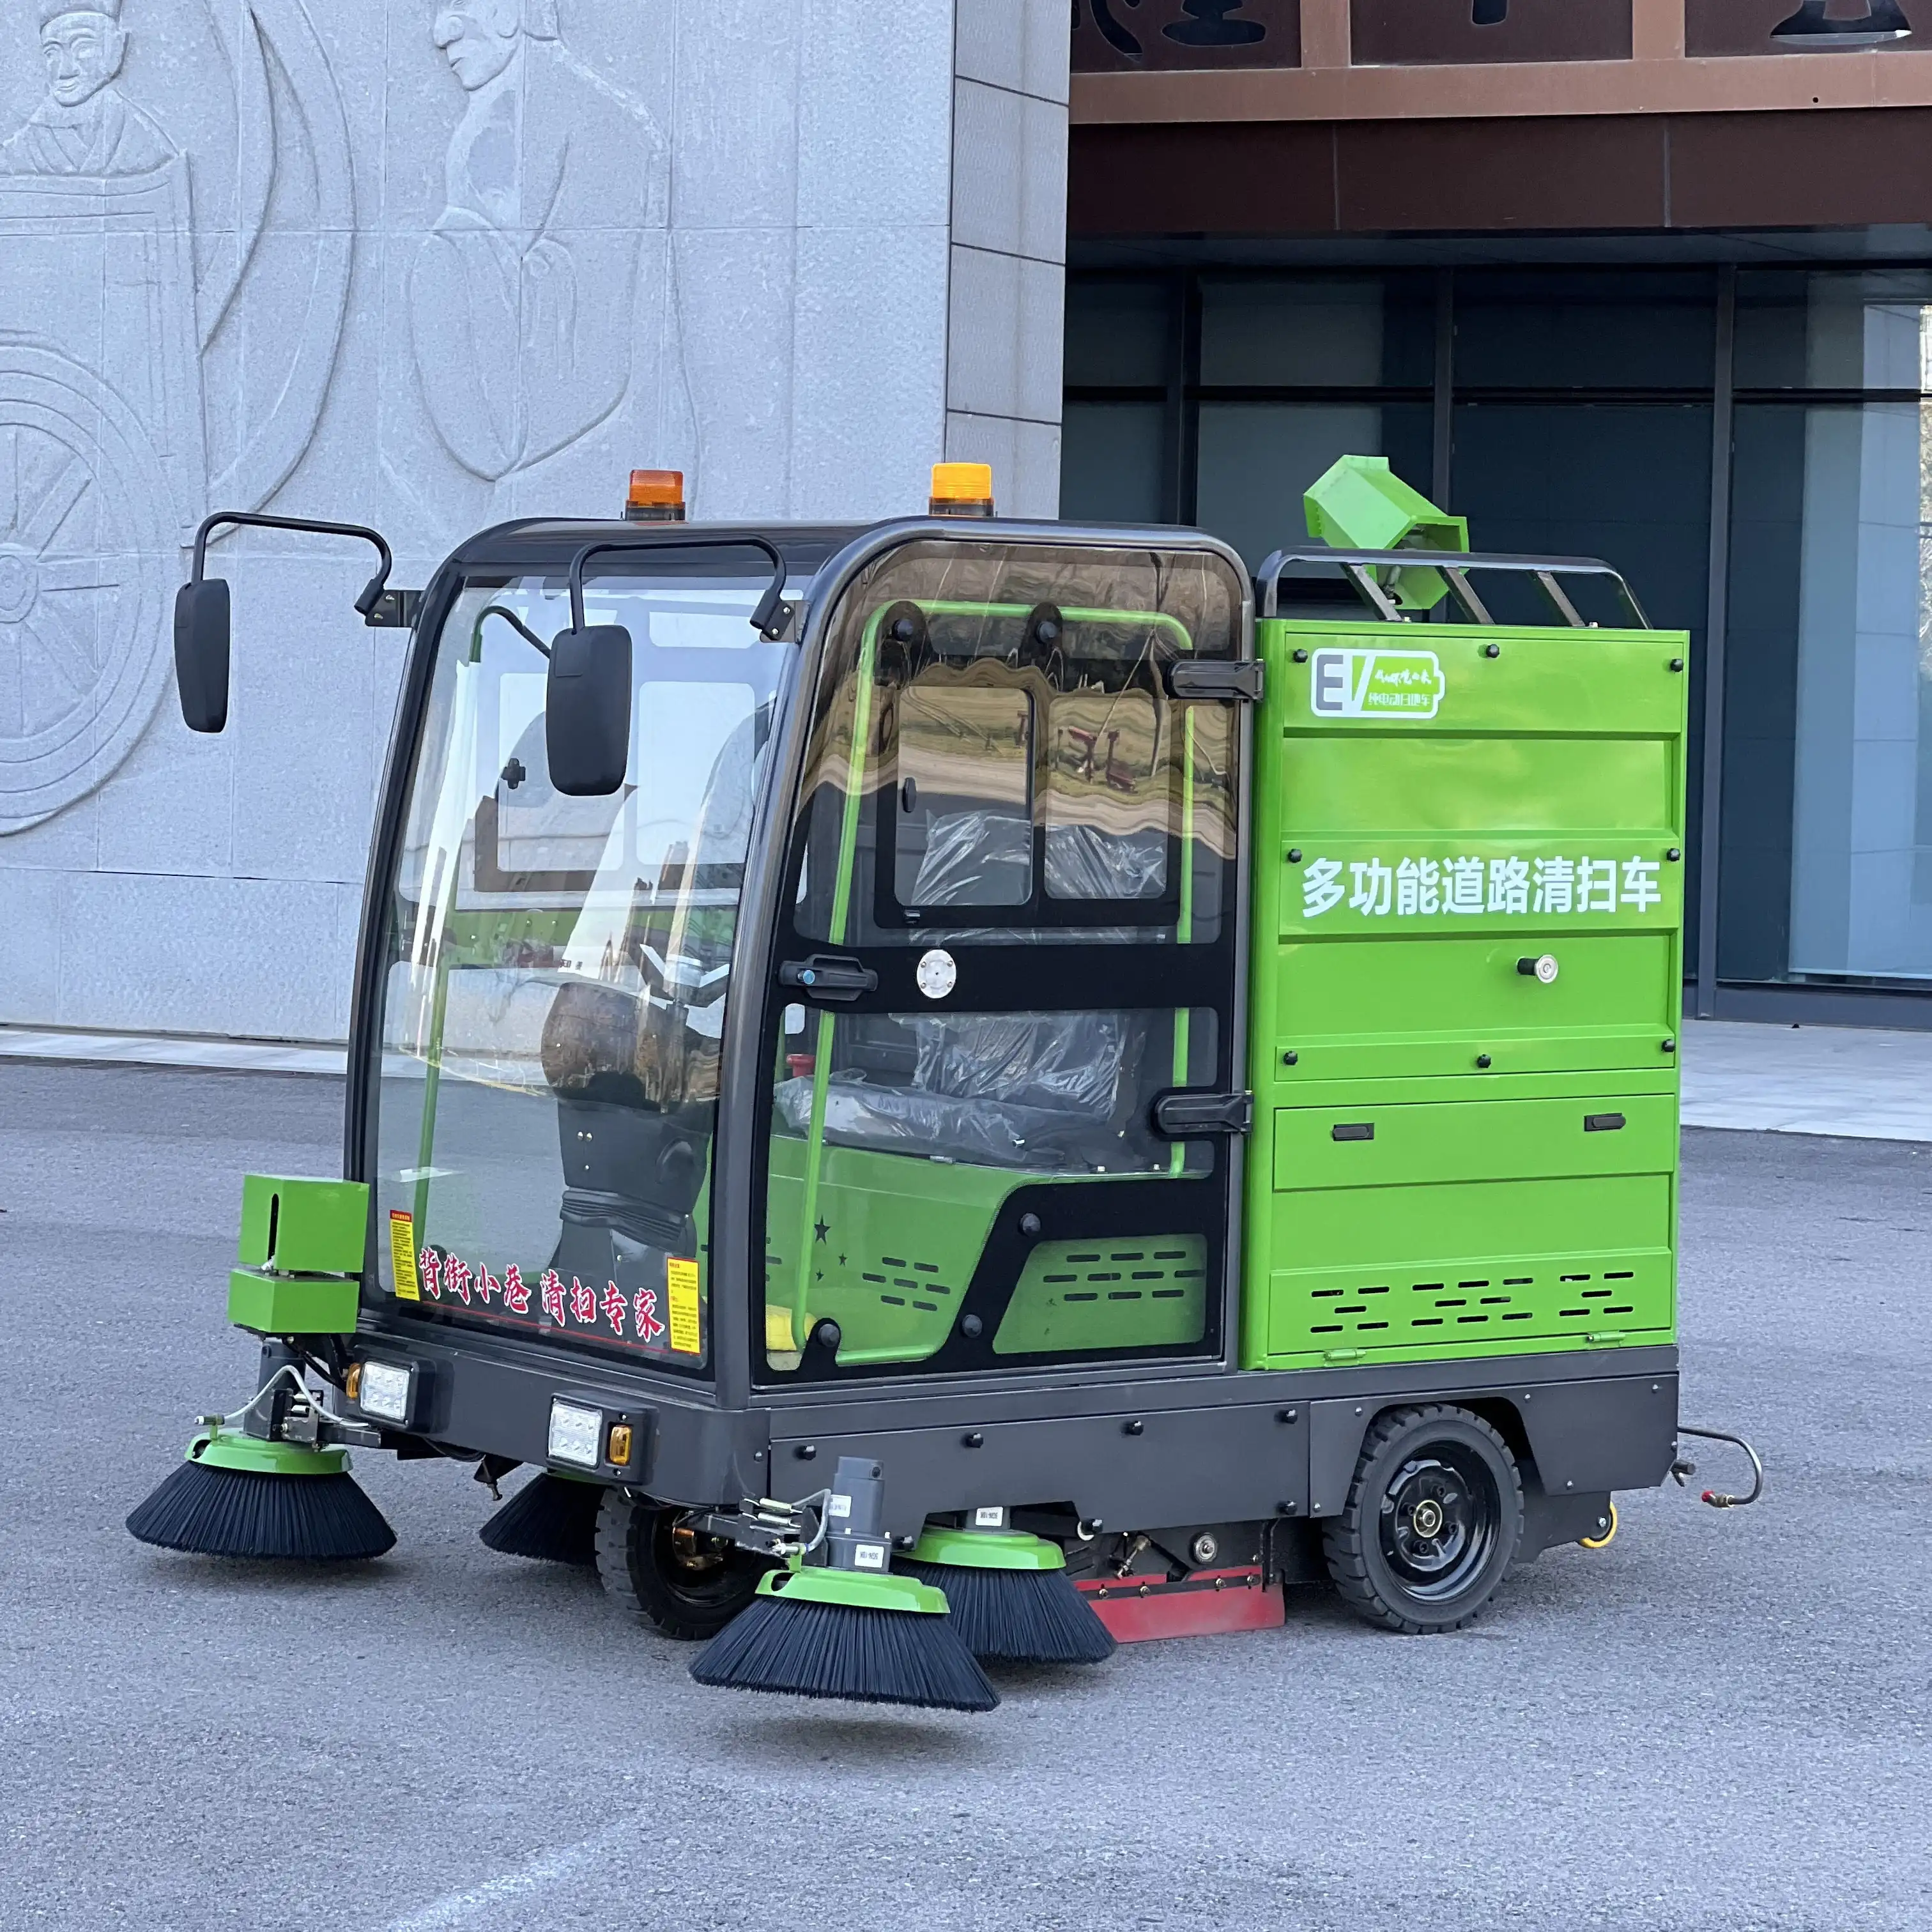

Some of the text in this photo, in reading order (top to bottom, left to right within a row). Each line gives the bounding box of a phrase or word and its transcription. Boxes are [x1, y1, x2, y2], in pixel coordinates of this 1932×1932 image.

[1316, 654, 1376, 723] EV
[1302, 855, 1662, 919] 多功能道路清扫车
